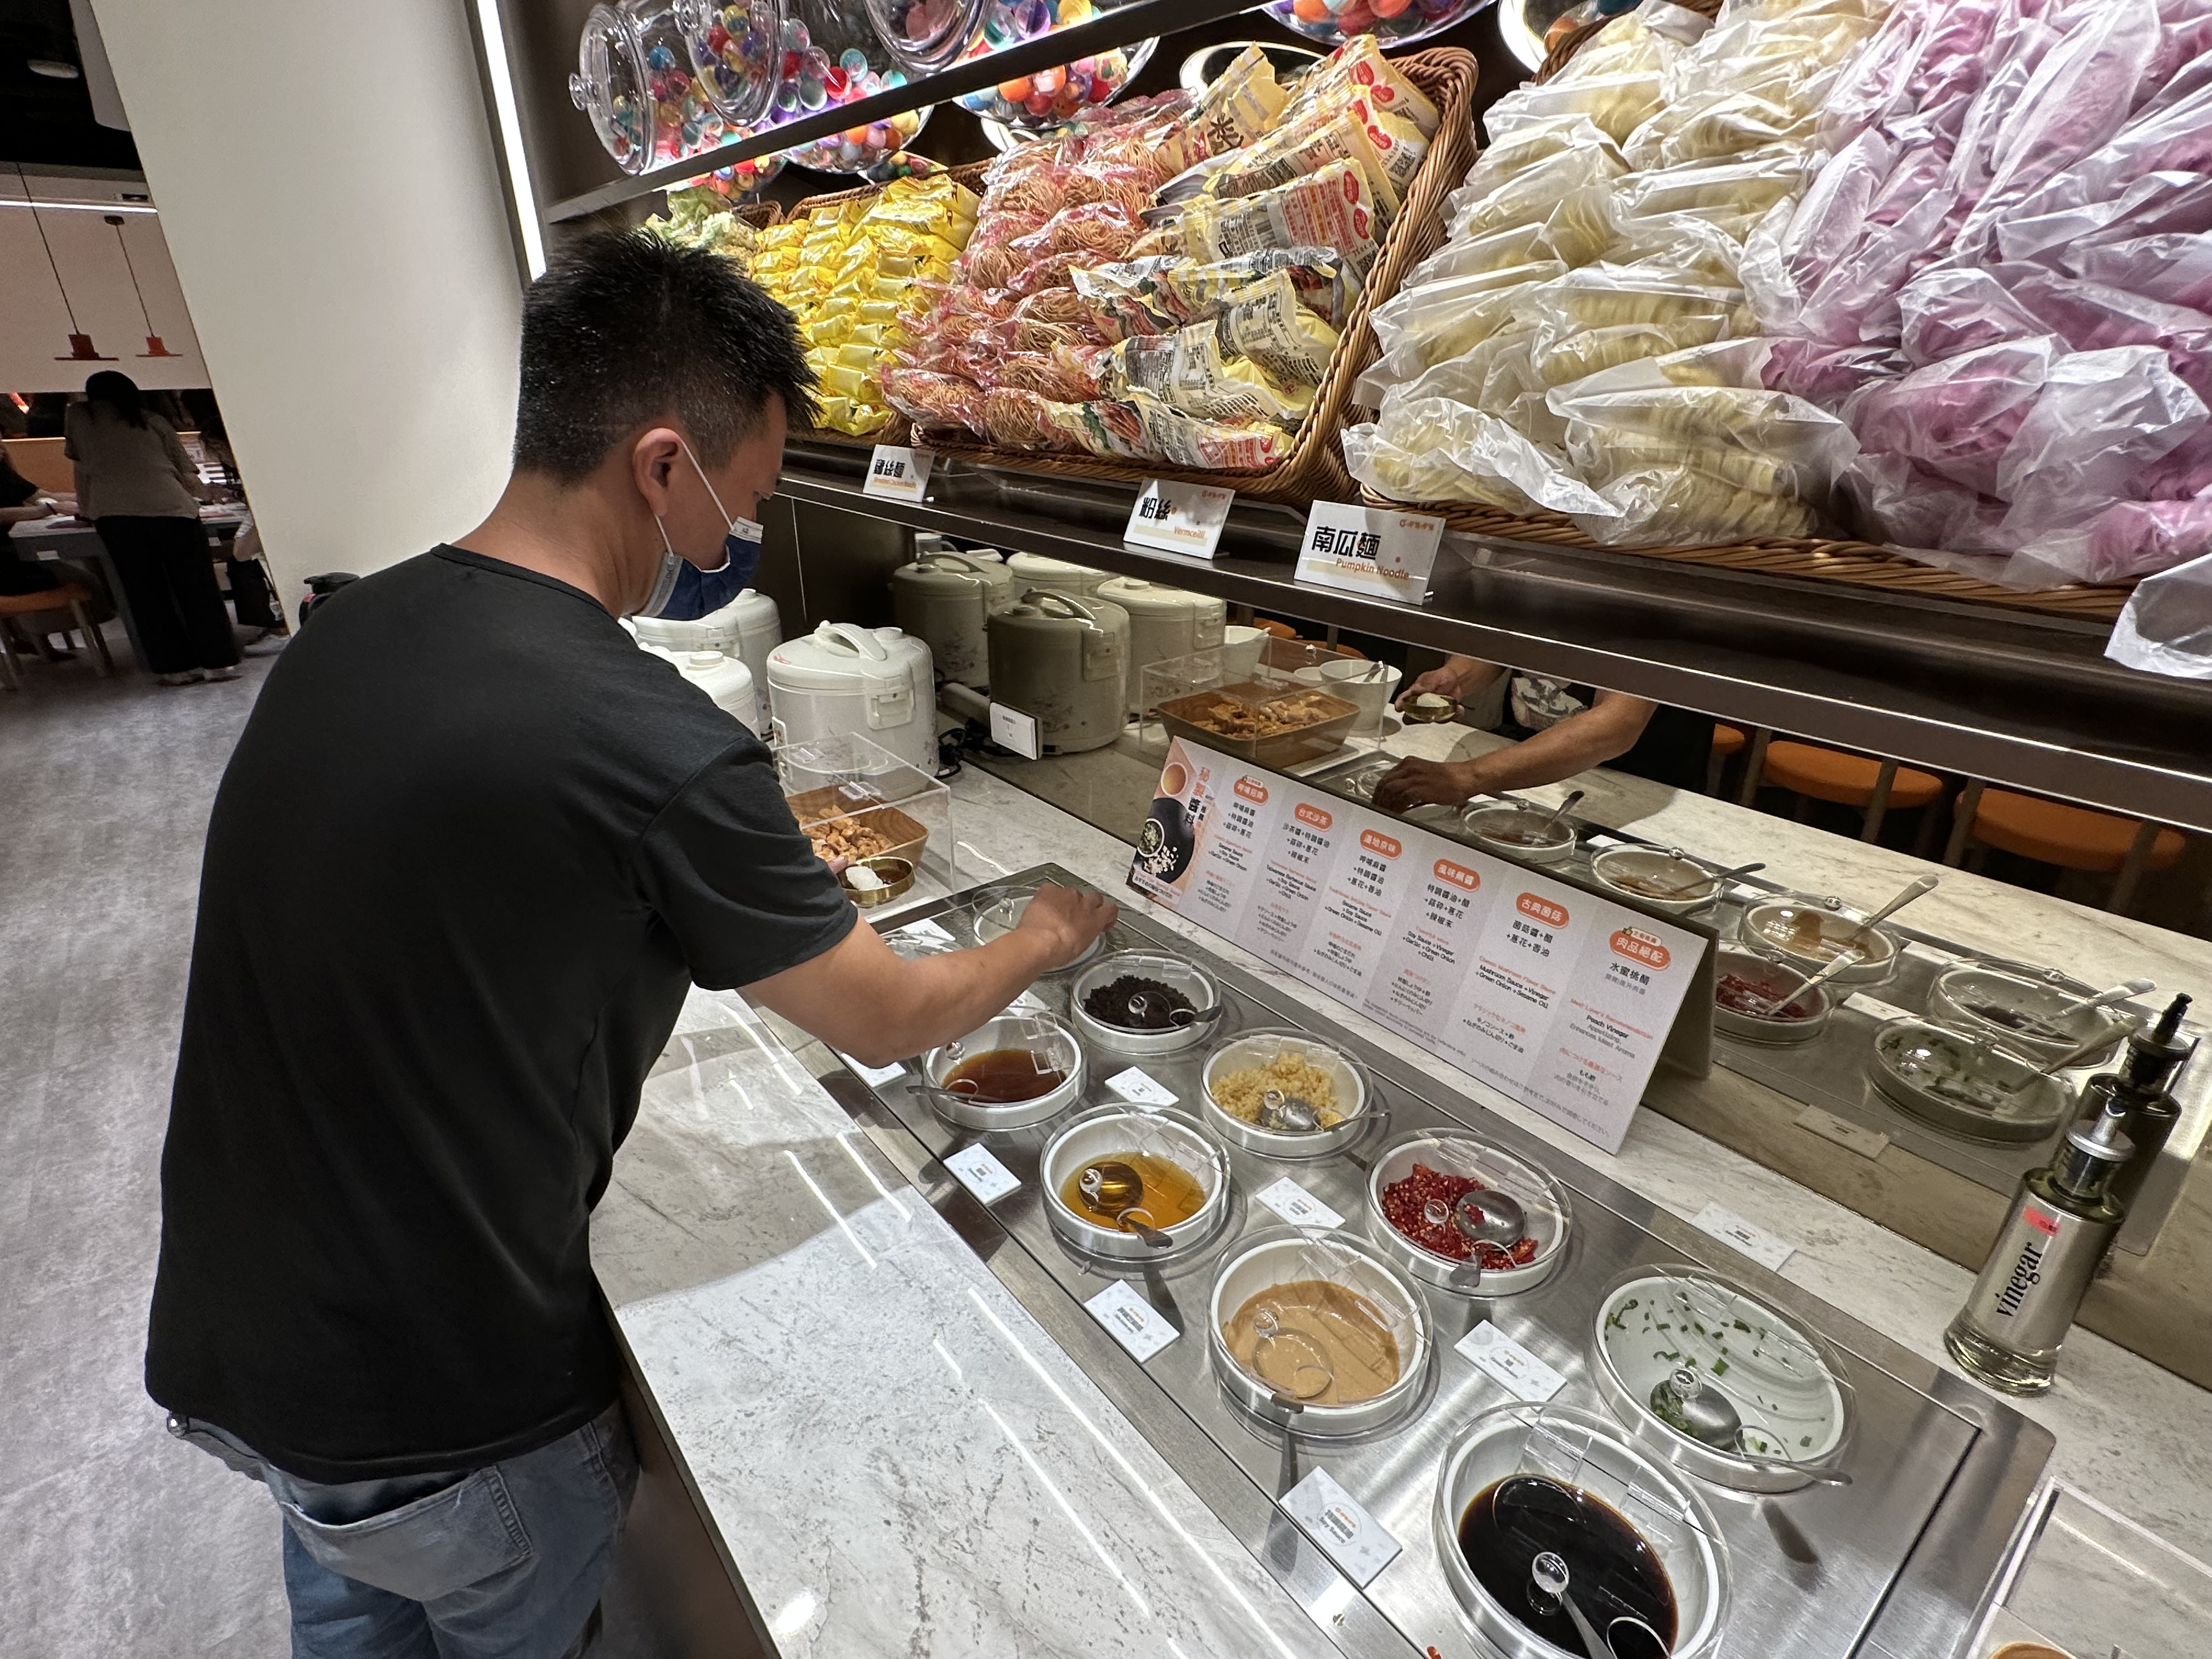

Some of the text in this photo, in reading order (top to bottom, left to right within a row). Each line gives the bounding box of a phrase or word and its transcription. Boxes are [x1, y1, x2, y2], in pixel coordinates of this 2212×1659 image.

[1138, 497, 1172, 521] 粉絲
[1311, 526, 1381, 561] 南瓜麵
[1335, 557, 1409, 580] Pumpkin Noodle
[1298, 808, 1328, 825] 台式沙茶
[1363, 833, 1396, 853] 道地京味
[1521, 899, 1561, 921] 古典菌菇
[1407, 930, 1417, 939] Soy
[1417, 934, 1432, 946] Sauce
[1440, 953, 1455, 964] Onion
[1616, 937, 1663, 963] 肉品絕配
[1479, 964, 1505, 980] Mushroom
[1506, 977, 1523, 989] Sauce
[1610, 962, 1650, 985] 水蜜桃醋
[1495, 979, 1512, 991] Onion
[1538, 1000, 1549, 1009] Oil
[1585, 1014, 1629, 1039] Peach Vinegar
[1597, 1036, 1613, 1048] Meat
[1614, 1045, 1635, 1059] Aroma
[1996, 1242, 2042, 1317] vinegar
[1329, 1527, 1346, 1544] Sauce
